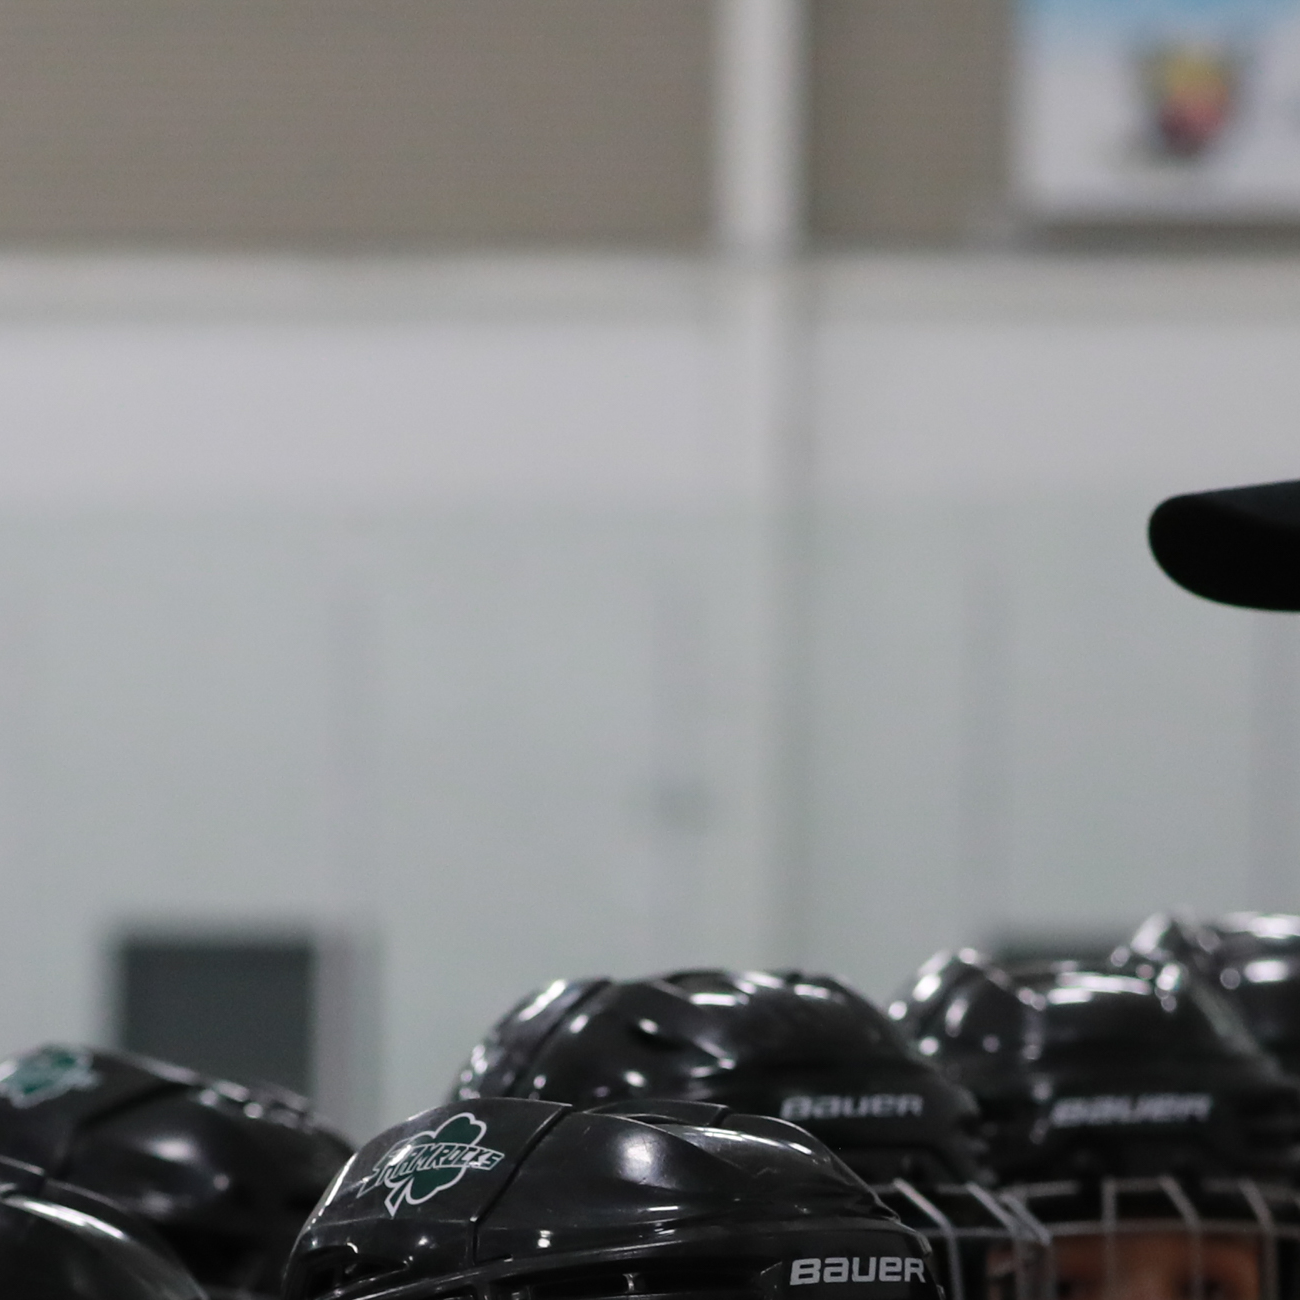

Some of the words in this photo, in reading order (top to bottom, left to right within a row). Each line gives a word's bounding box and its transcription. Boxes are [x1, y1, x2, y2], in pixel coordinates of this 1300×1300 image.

[780, 1093, 924, 1121] BAUER
[356, 1139, 506, 1199] SHAMROCKS
[789, 1256, 927, 1286] BAUER
